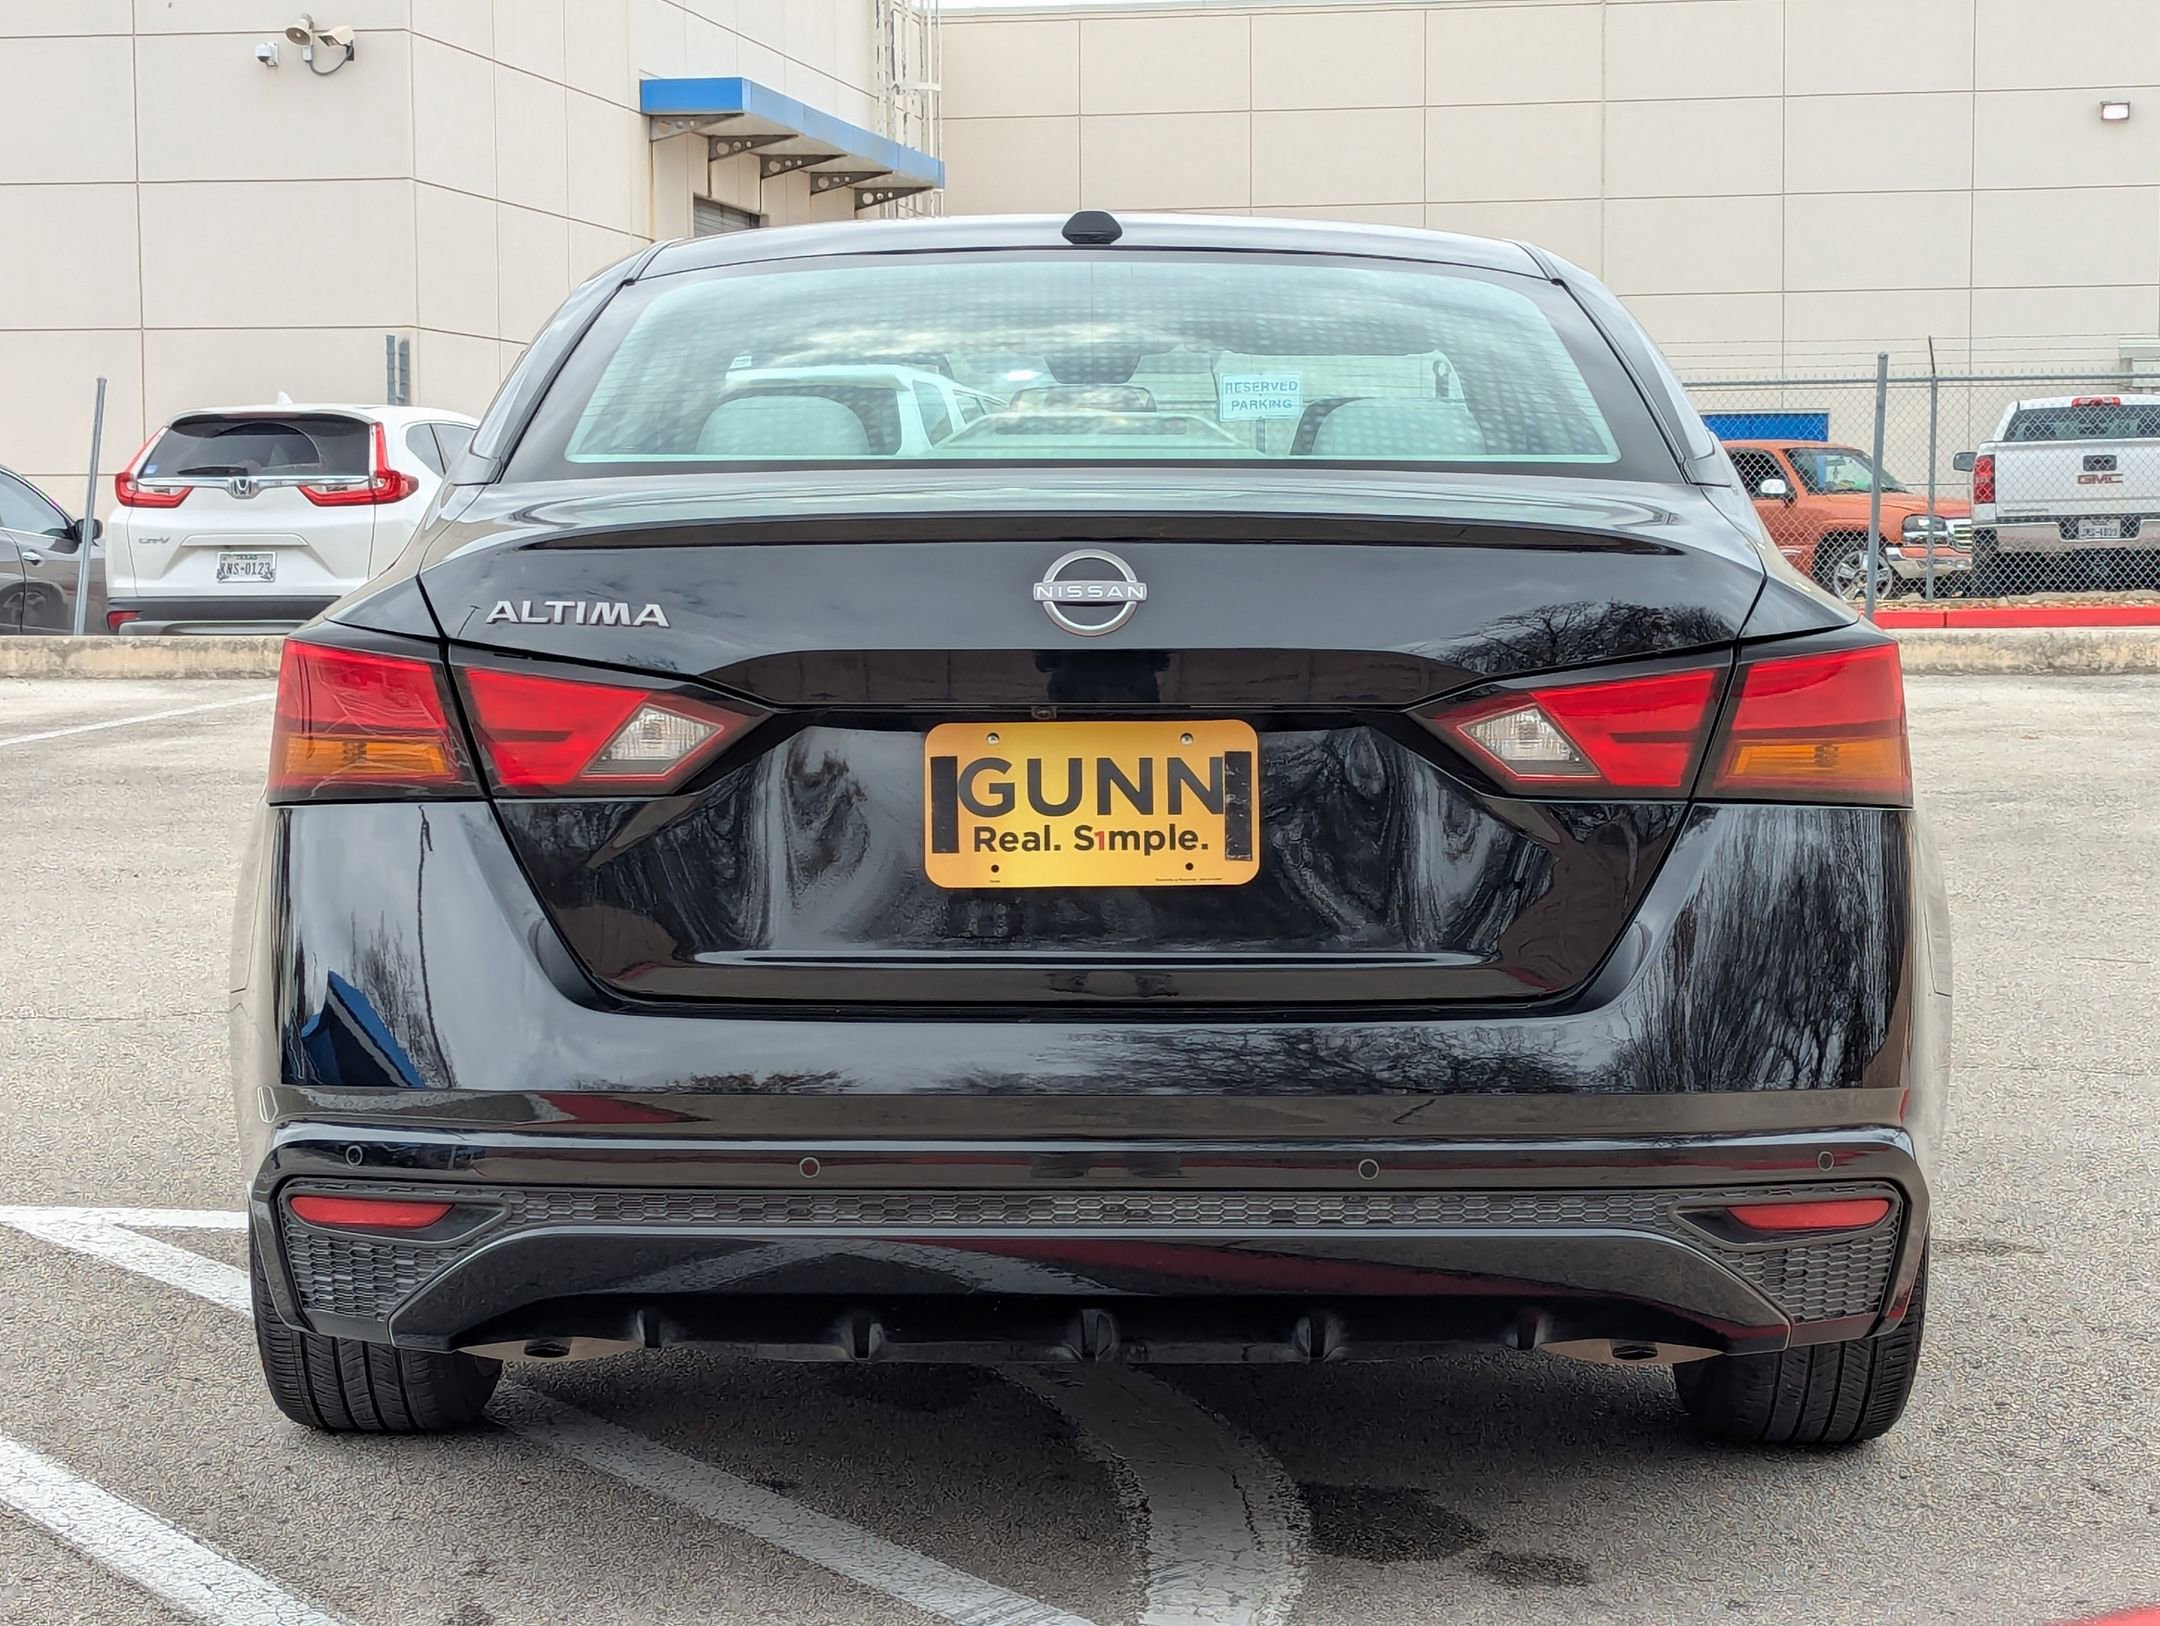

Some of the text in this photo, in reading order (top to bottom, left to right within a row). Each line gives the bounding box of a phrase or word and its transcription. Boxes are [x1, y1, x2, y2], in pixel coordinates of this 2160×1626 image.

[1224, 380, 1299, 395] RESERVED
[1230, 399, 1293, 412] PARKING
[2077, 473, 2124, 485] GMC
[1036, 585, 1145, 599] NISSAN
[484, 599, 671, 628] ALTIMA
[958, 756, 1225, 818] GUNN
[973, 825, 1062, 853] Real.
